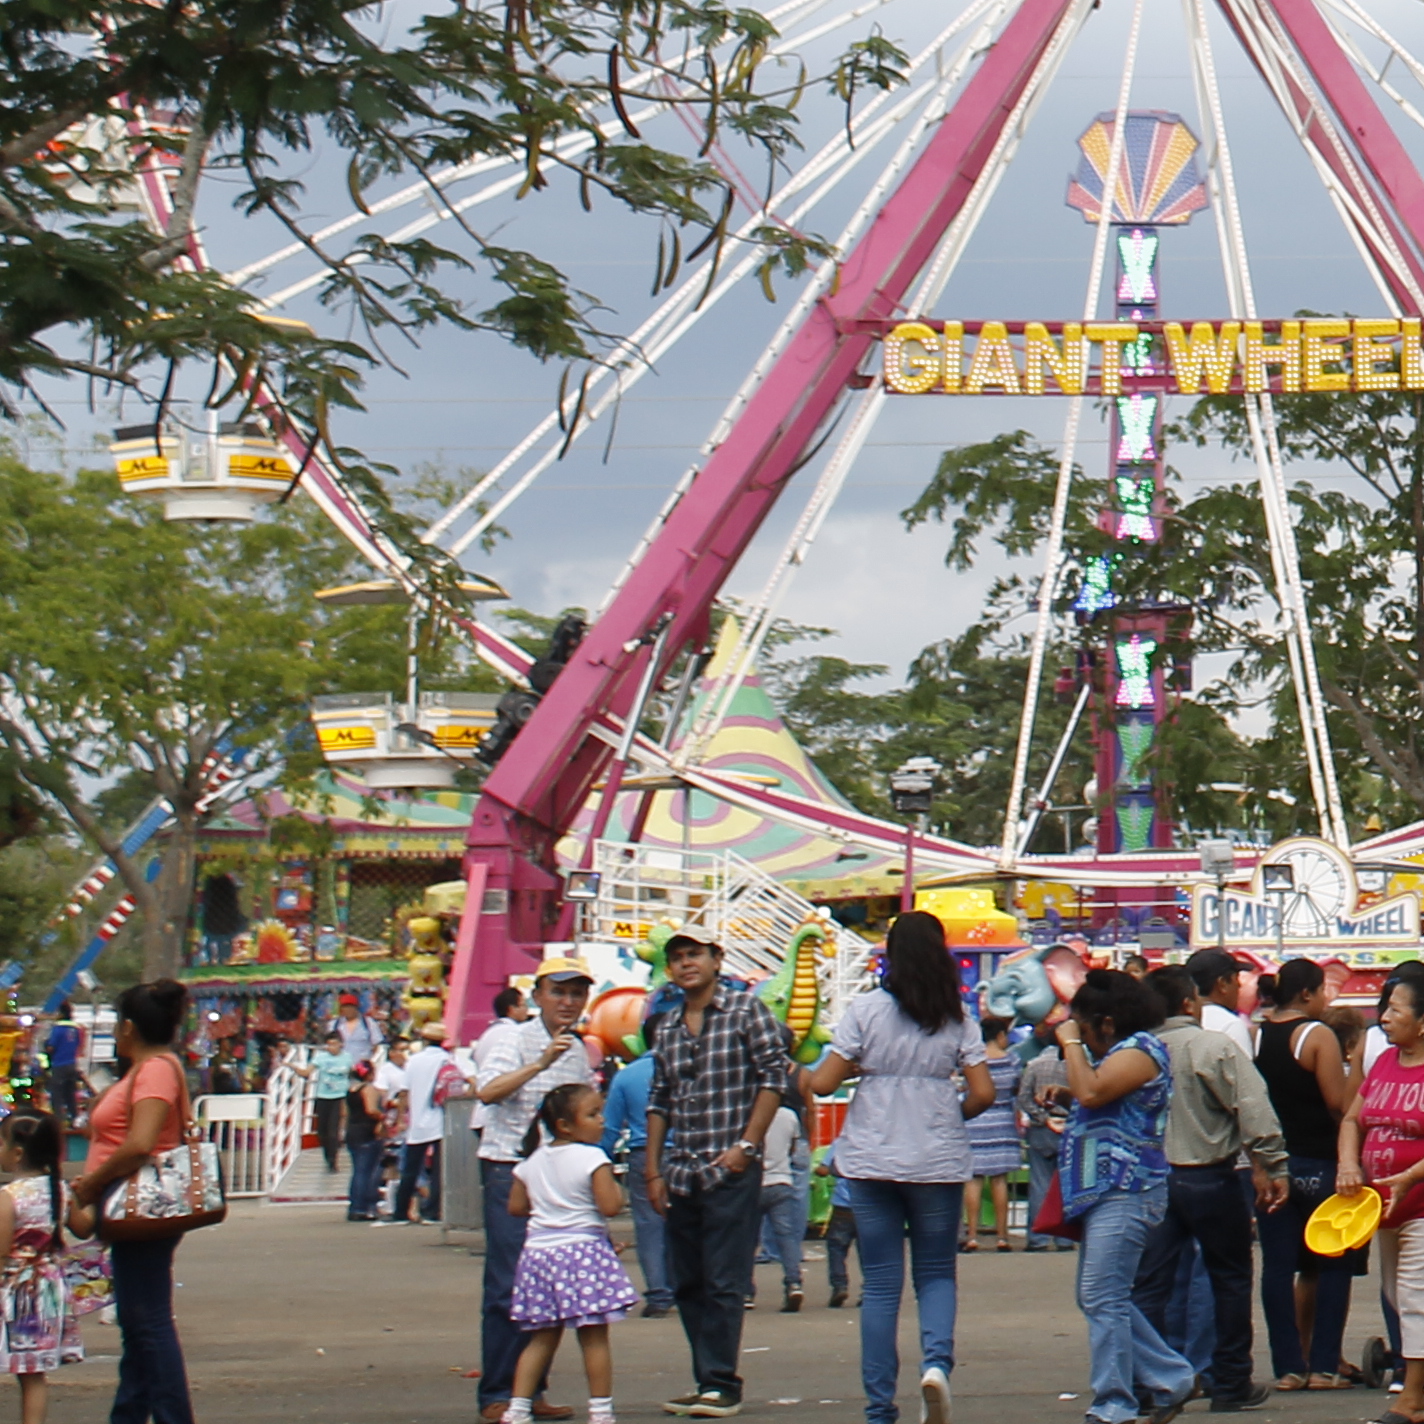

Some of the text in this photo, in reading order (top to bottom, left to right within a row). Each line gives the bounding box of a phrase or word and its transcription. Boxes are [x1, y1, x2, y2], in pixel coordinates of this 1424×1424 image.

[884, 320, 1138, 394] GIANT
[1335, 903, 1412, 936] WHEEL
[1365, 1079, 1395, 1109] AN
